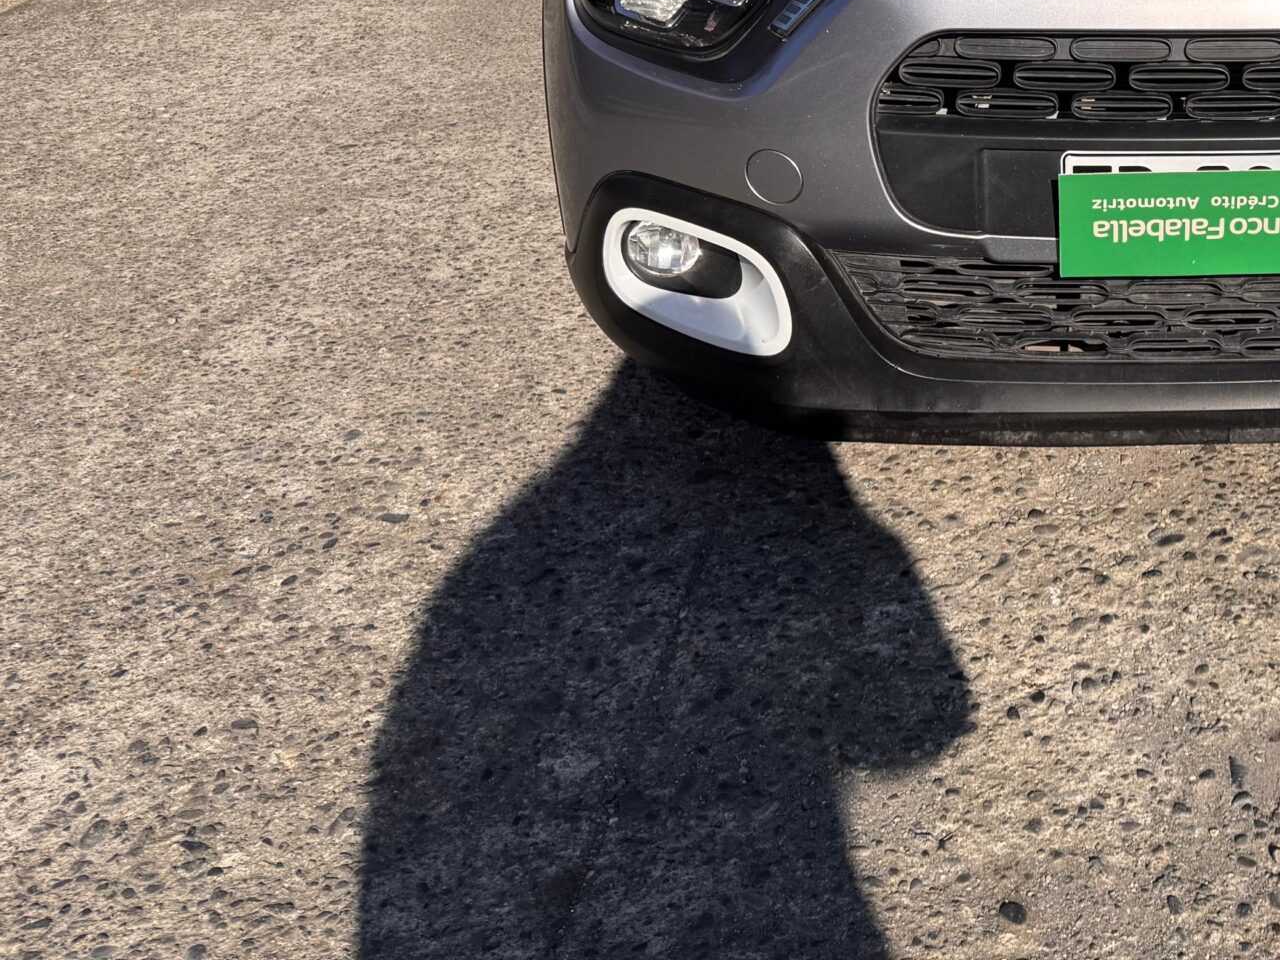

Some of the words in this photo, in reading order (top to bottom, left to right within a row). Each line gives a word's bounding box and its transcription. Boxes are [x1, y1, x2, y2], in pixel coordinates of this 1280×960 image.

[1092, 197, 1199, 211] Automotriz
[1211, 196, 1279, 209] Crédito
[1093, 218, 1224, 242] Falabella
